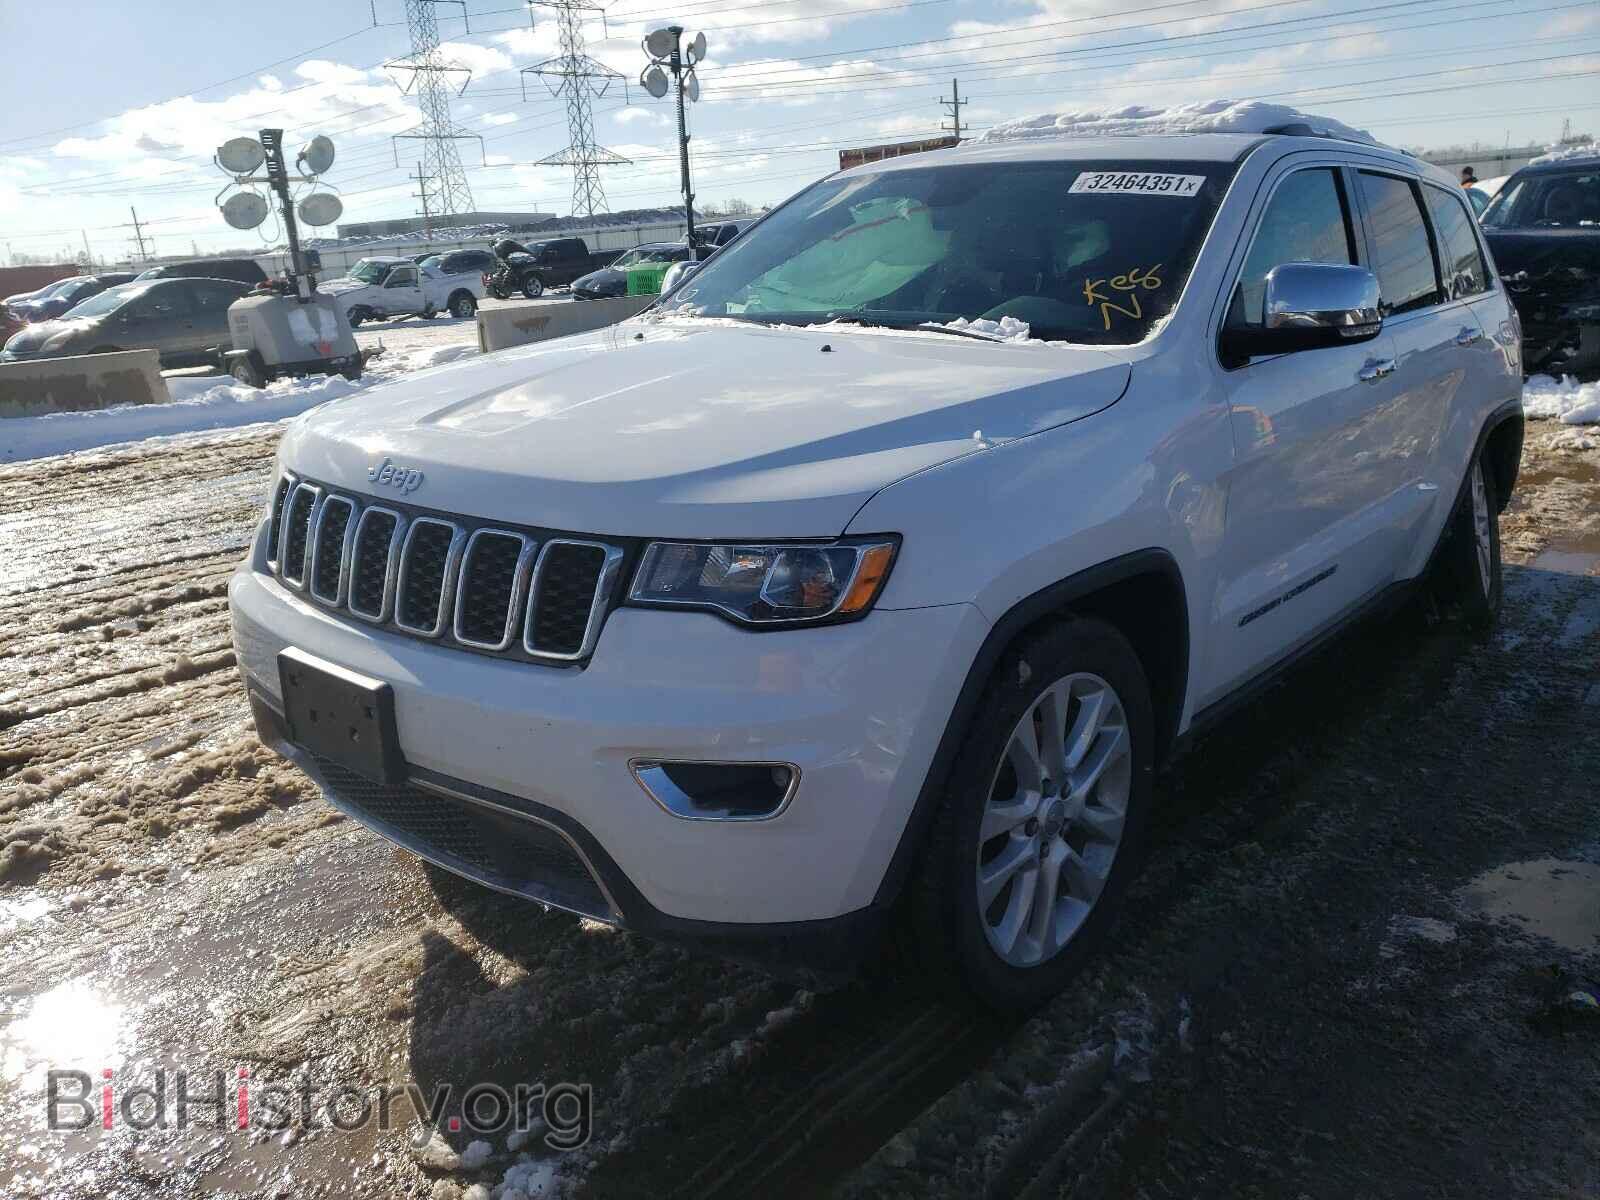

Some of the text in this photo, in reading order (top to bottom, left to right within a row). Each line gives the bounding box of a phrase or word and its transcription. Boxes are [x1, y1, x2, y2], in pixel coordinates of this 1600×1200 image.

[1088, 174, 1186, 191] 32464351
[1101, 294, 1142, 330] N
[368, 457, 424, 496] Jeep
